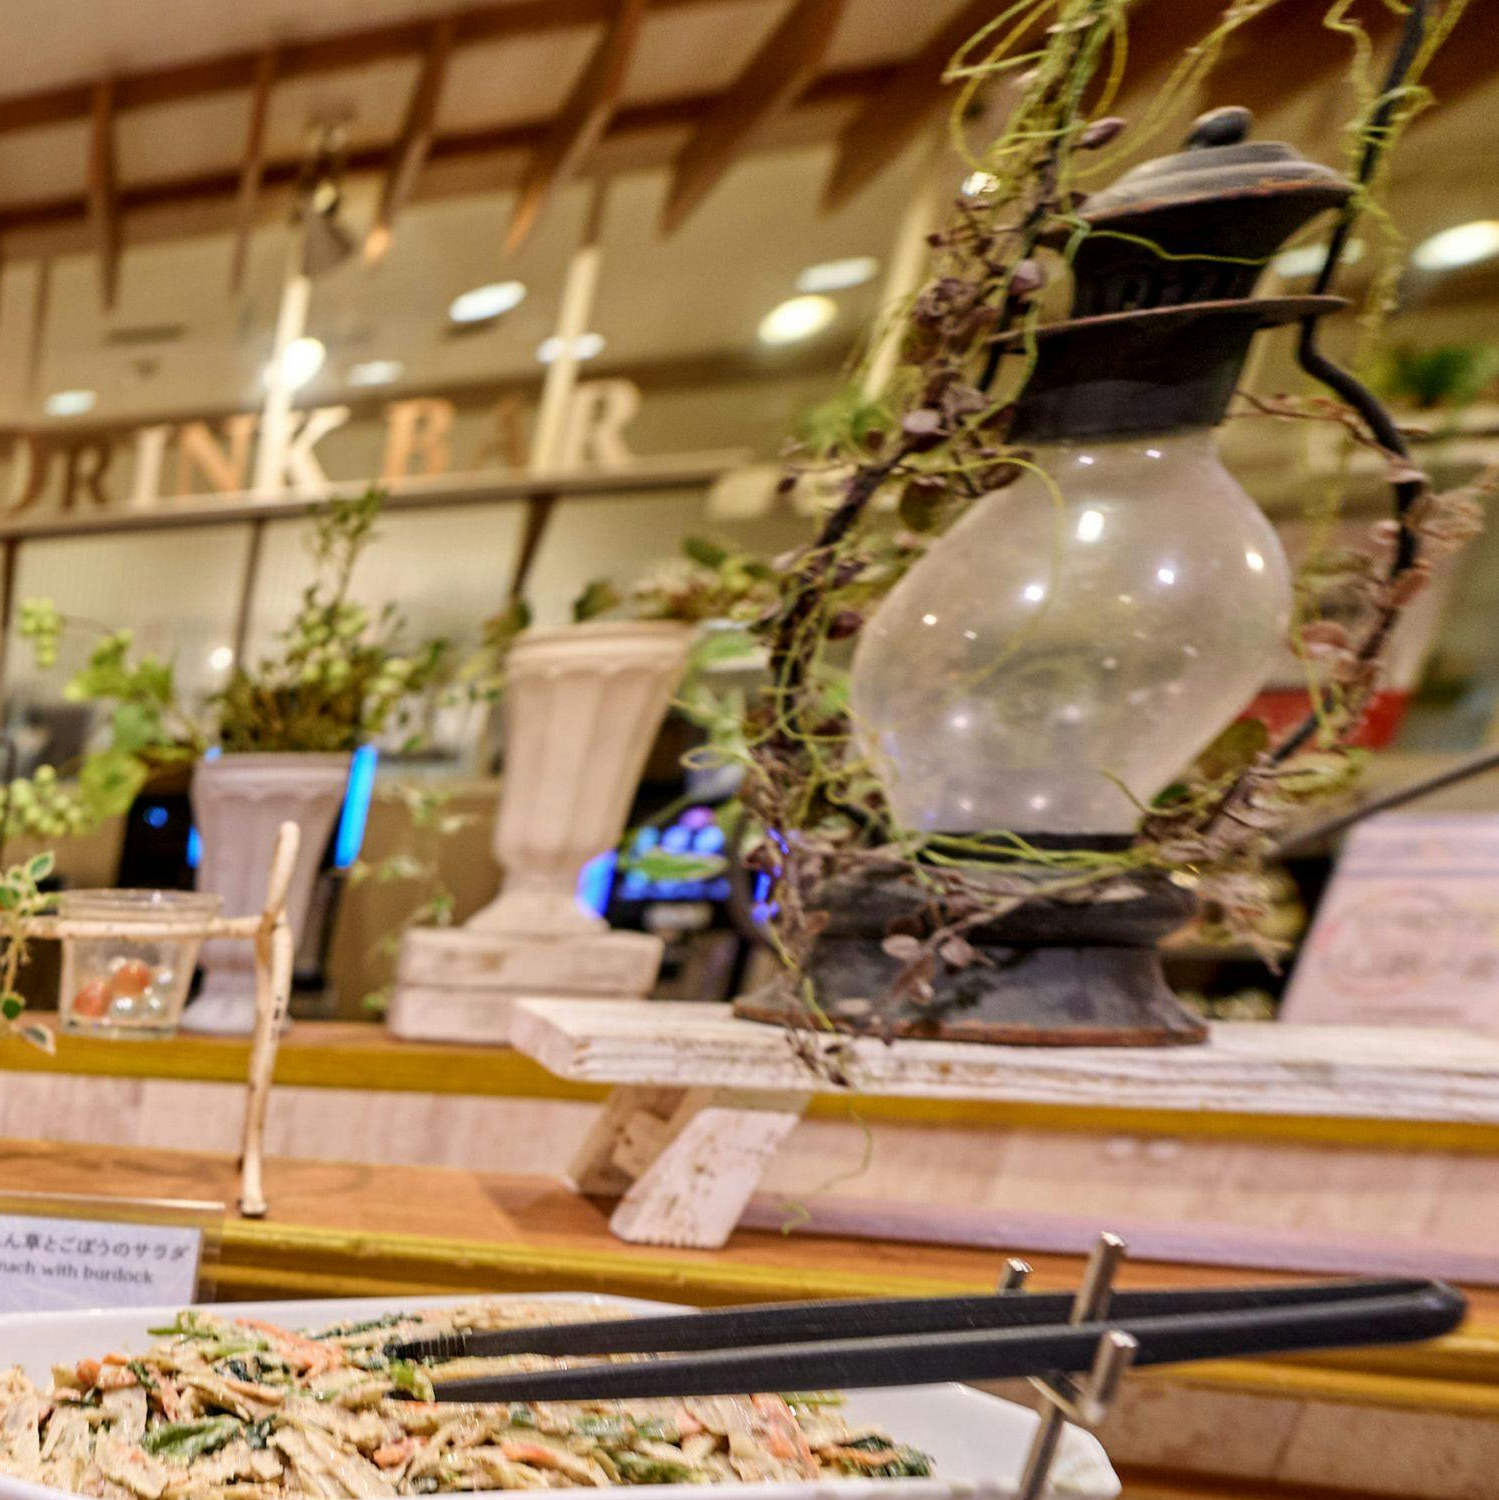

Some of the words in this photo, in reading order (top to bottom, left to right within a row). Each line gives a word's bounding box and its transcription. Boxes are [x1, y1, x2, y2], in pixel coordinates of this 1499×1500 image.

[379, 377, 644, 489] BAR
[41, 1261, 79, 1281] with
[83, 1265, 154, 1285] burdock
